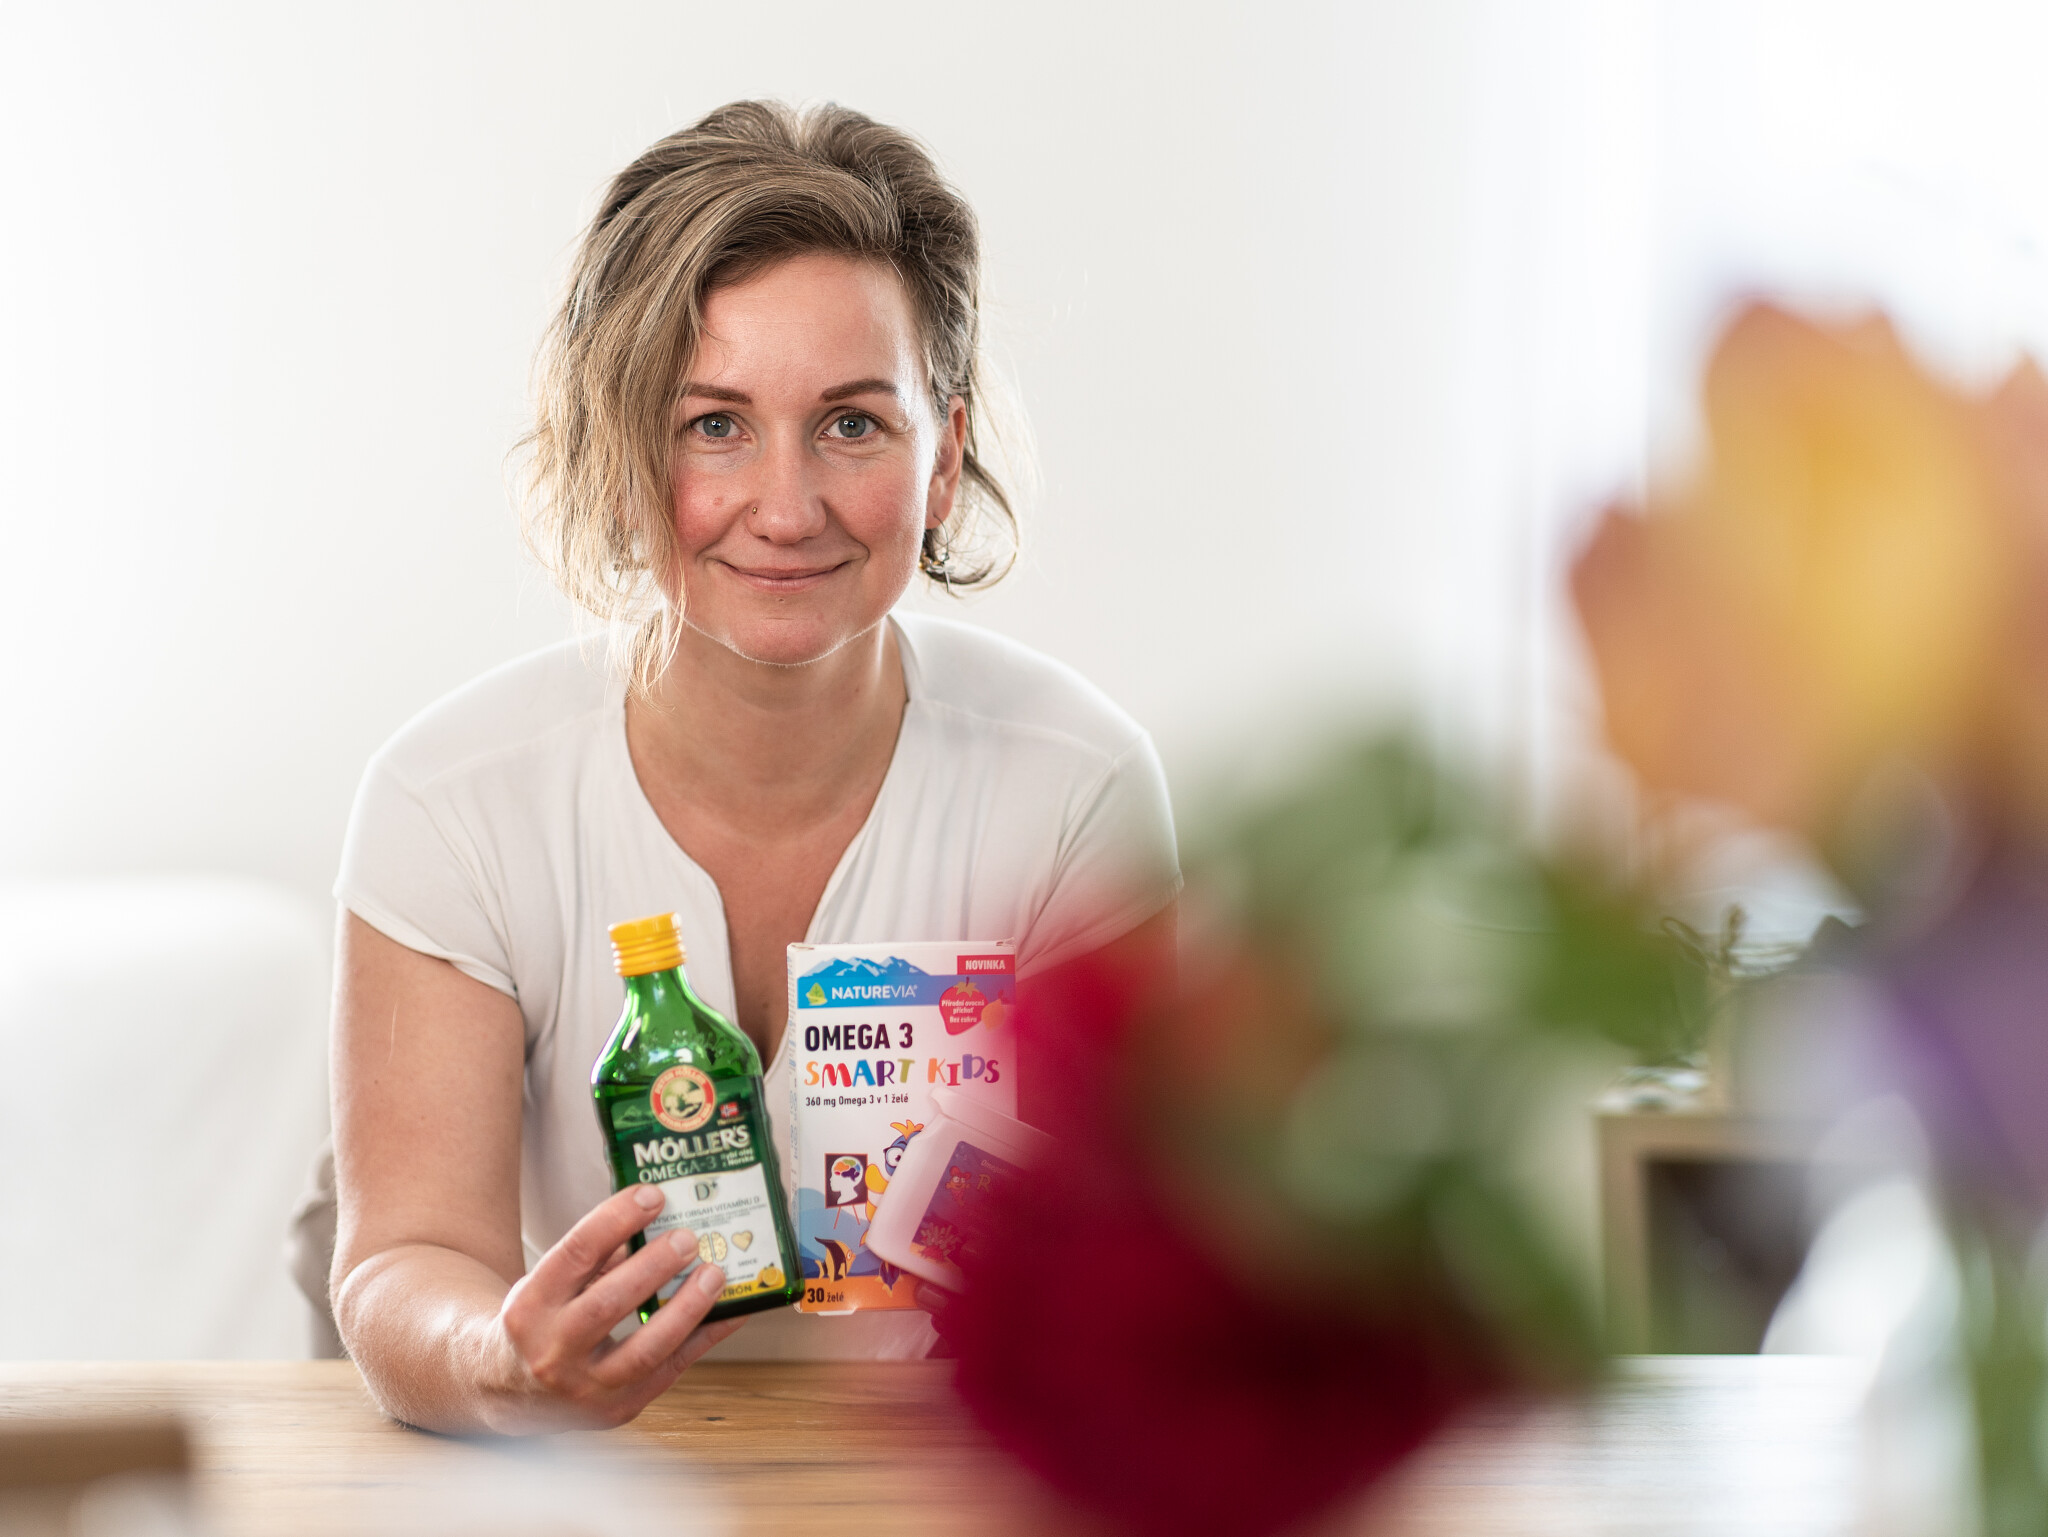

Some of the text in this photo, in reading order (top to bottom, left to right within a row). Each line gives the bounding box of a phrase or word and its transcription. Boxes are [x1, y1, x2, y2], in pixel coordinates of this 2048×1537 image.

[965, 959, 1006, 971] NOVINKA
[831, 985, 916, 999] NATUREVIA
[804, 1022, 914, 1052] OMEGA 3
[804, 1053, 1000, 1089] SMART KIDS
[805, 1093, 909, 1108] 360 mg Omega 3 v 1 želé
[633, 1124, 750, 1168] MÖLLER'S
[639, 1155, 717, 1184] OMEGA-3
[721, 1283, 752, 1299] TRÓN
[807, 1287, 844, 1303] 30 želé
